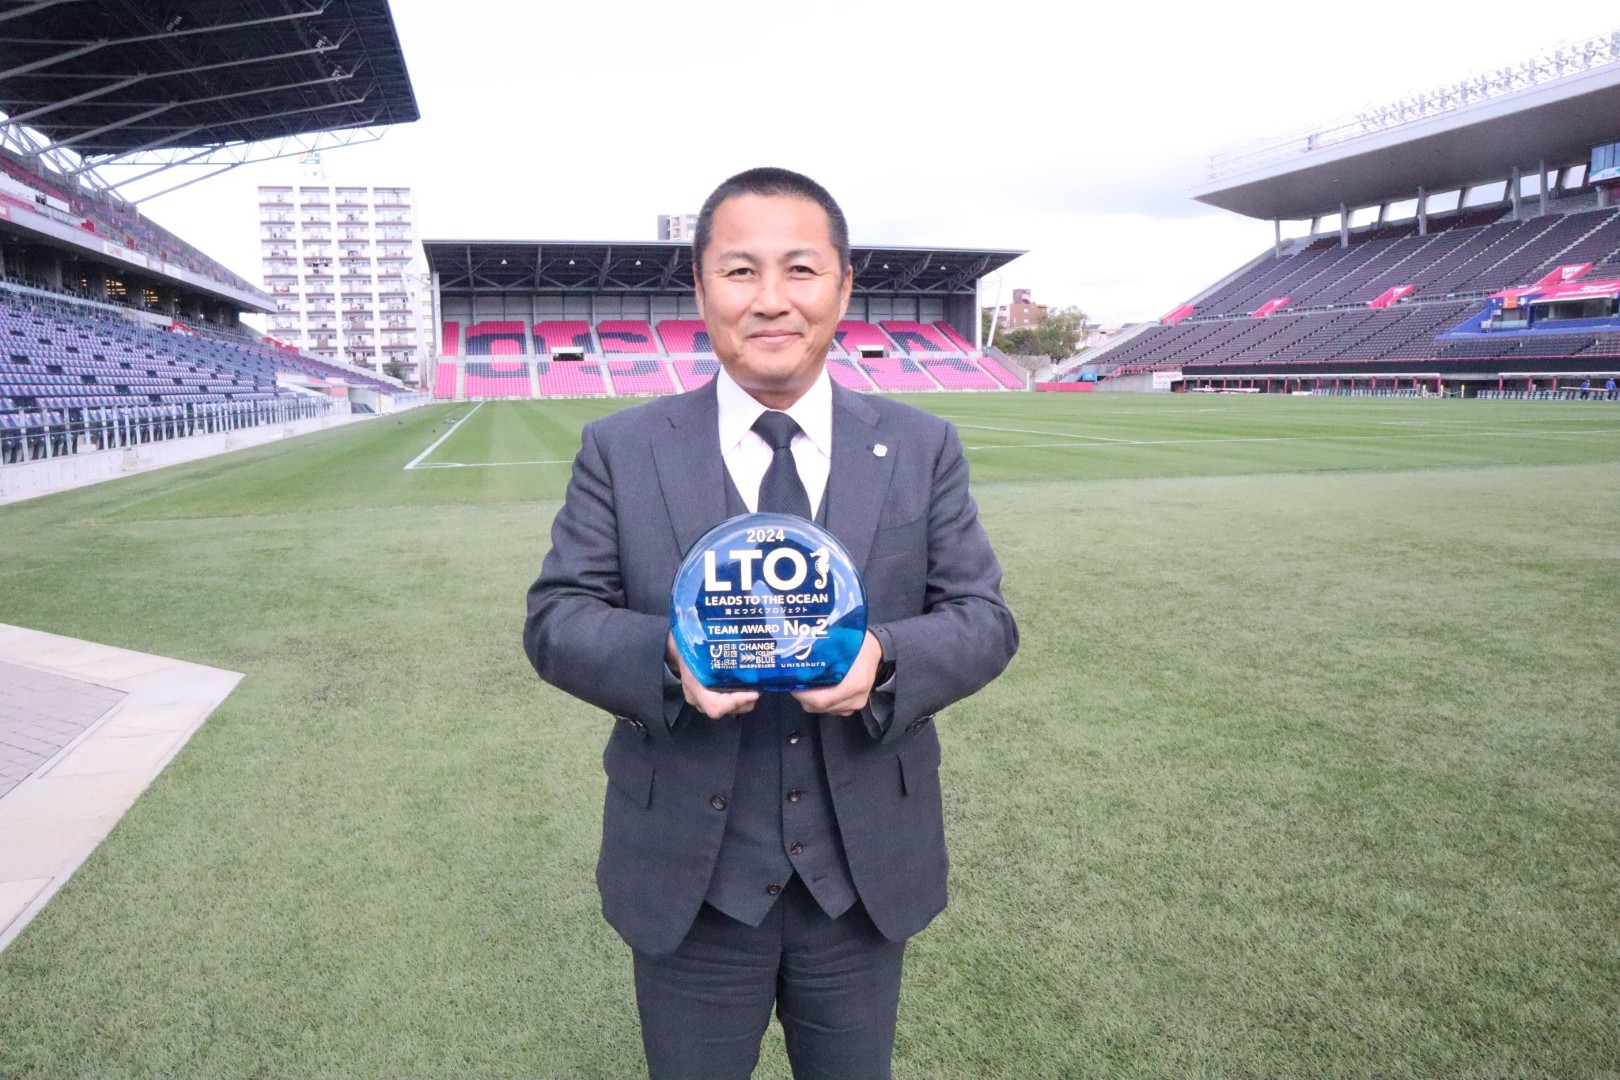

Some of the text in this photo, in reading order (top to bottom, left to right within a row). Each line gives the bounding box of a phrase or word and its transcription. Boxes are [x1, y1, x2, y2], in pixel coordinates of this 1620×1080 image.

[746, 529, 785, 543] 2024
[704, 547, 808, 592] LTO
[705, 593, 828, 606] LEADS TO THE OCEAN
[724, 606, 808, 615] 海につづくプロジェクト
[707, 618, 828, 636] TEAM AWARD No.2
